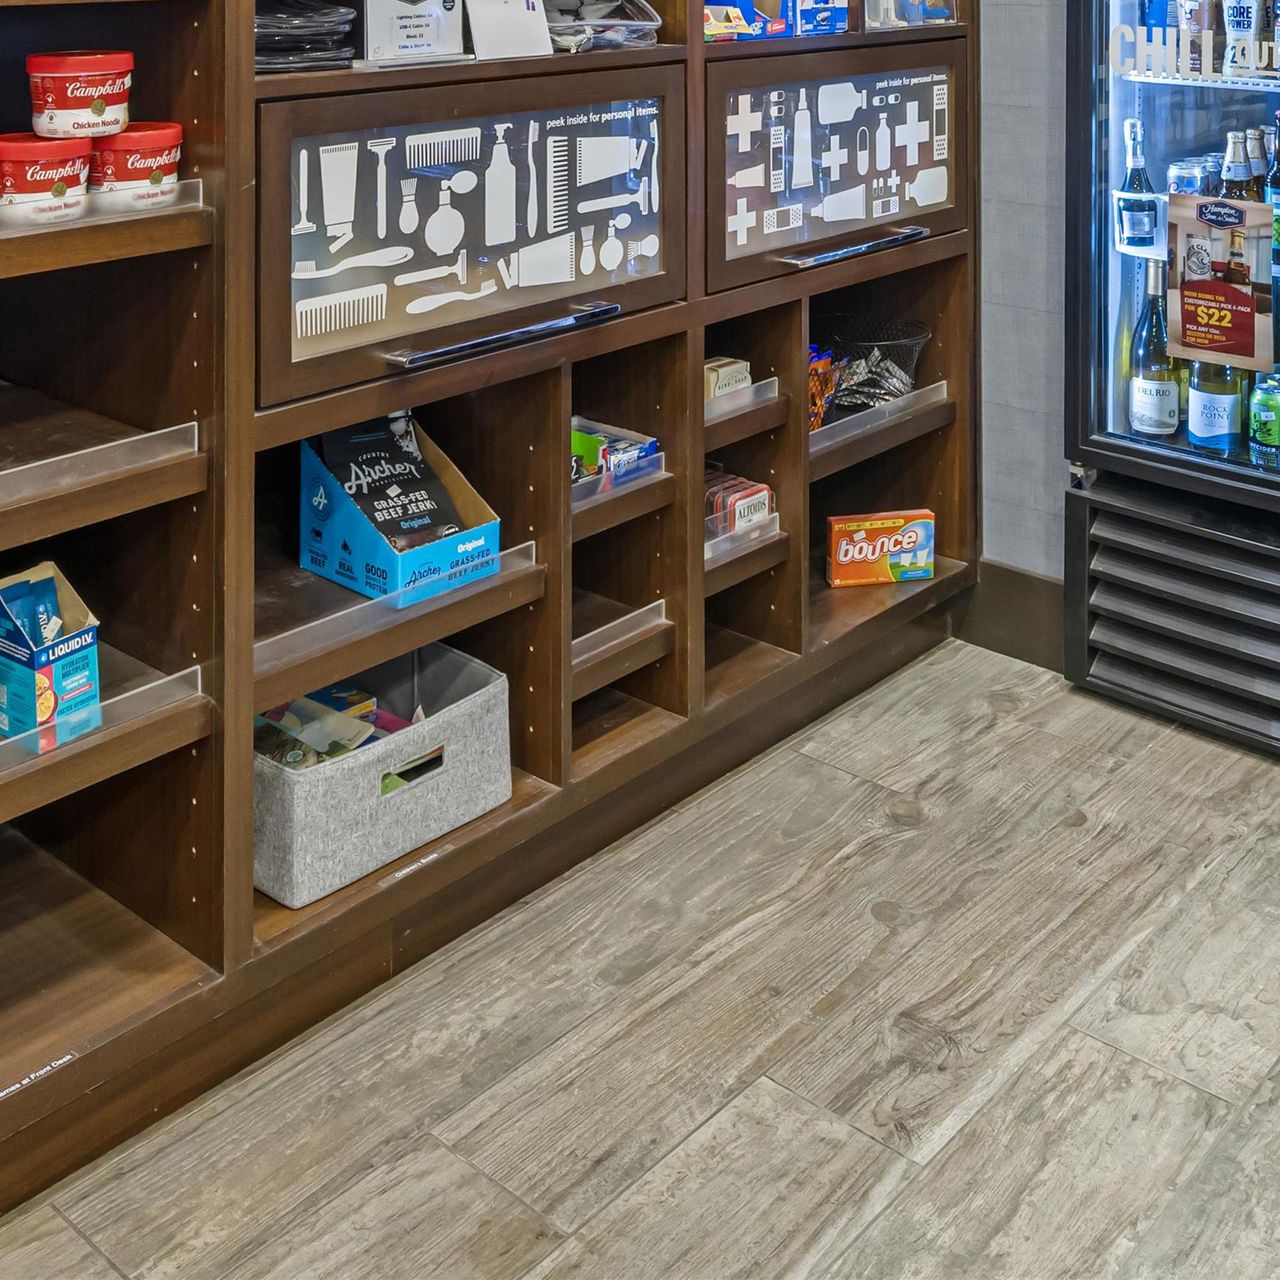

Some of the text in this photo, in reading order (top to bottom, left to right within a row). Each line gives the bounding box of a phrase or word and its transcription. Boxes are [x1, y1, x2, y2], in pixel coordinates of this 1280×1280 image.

[1227, 4, 1252, 20] CORE
[1227, 18, 1253, 31] POWER
[1109, 23, 1222, 81] CHILL
[546, 105, 659, 131] peek inside for personal items.
[1201, 204, 1240, 217] Hampton
[1197, 306, 1233, 328] $22
[1220, 302, 1232, 310] PICK
[357, 451, 392, 463] COUNTRY
[344, 457, 421, 495] Archer
[373, 490, 428, 511] GRASS-FED
[374, 500, 438, 523] BEEF JERKY
[736, 497, 768, 521] ALTOIDS
[400, 515, 432, 530] Original
[457, 535, 486, 554] Original
[836, 527, 919, 565] bounce
[449, 548, 491, 570] GRASS-FED
[364, 562, 388, 581] GOOD
[48, 631, 93, 661] LIQUID I.V.
[21, 1076, 31, 1086] at
[30, 1065, 53, 1081] Front
[51, 1053, 74, 1069] Desk
